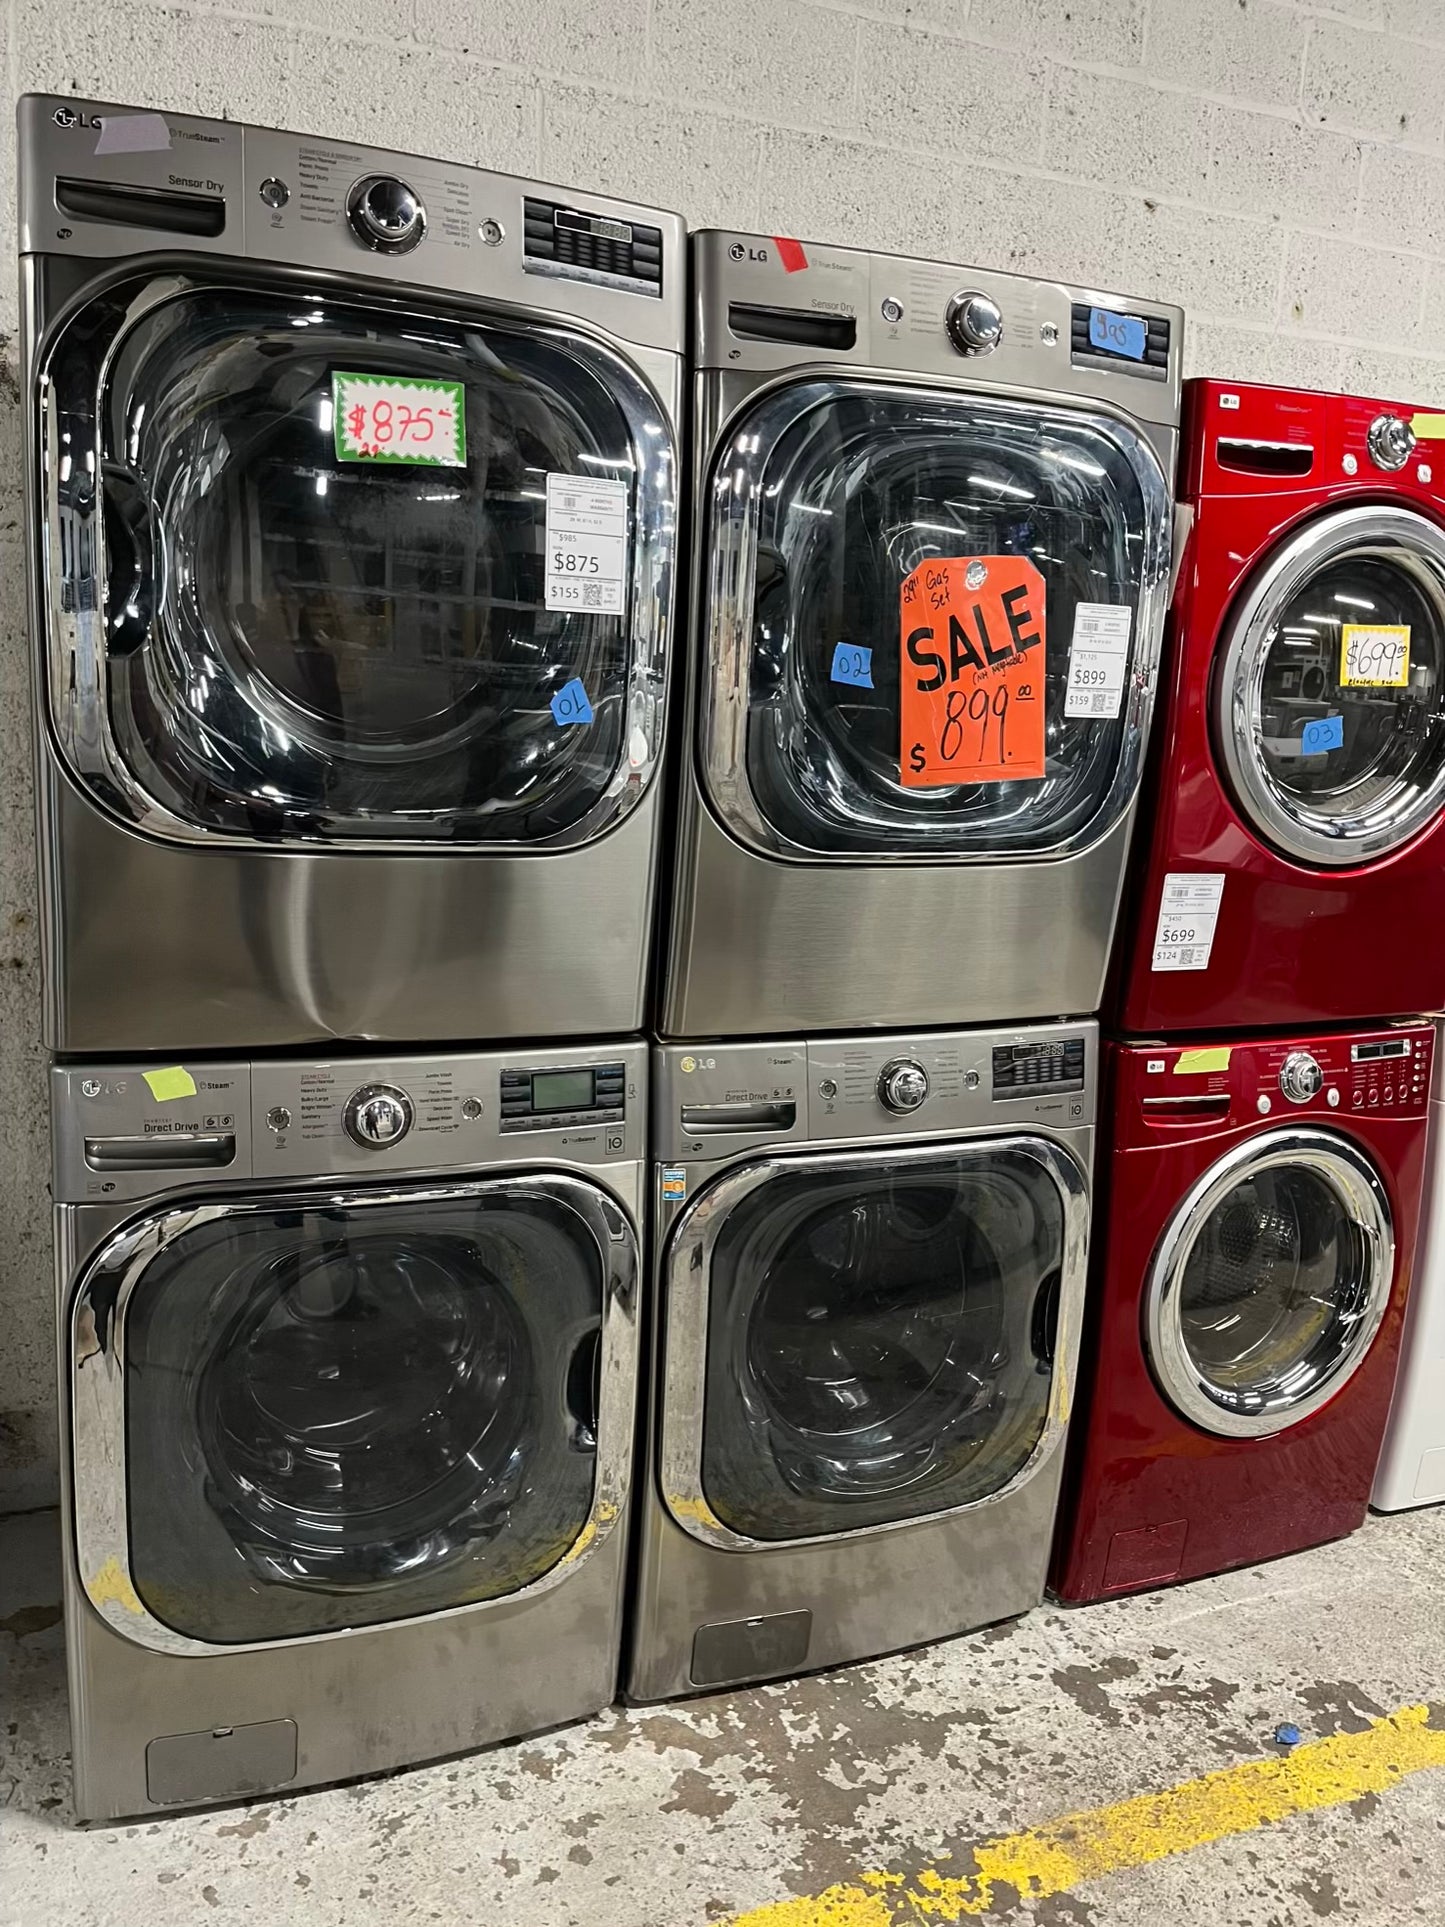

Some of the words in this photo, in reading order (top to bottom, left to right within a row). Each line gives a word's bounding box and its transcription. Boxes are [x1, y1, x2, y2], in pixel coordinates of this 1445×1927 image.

[168, 174, 203, 189] Sensor
[206, 179, 225, 194] Dry
[749, 248, 768, 263] LG
[811, 298, 840, 311] Sensor
[840, 302, 855, 314] Dry
[559, 533, 577, 542] $985
[554, 551, 599, 573] $875
[926, 568, 950, 590] Gas
[551, 586, 579, 599] $155
[931, 589, 951, 610] Set
[907, 584, 1042, 692] SALE
[838, 652, 871, 678] 02
[1074, 669, 1106, 686] $899
[1069, 695, 1089, 705] $159
[1308, 723, 1334, 744] 03
[1162, 928, 1195, 944] $699
[1157, 951, 1177, 960] $124
[697, 1058, 716, 1070] LG
[104, 1080, 127, 1095] LG
[725, 1093, 748, 1102] Direct
[749, 1092, 768, 1101] Drive
[144, 1122, 172, 1133] Direct
[174, 1122, 199, 1132] Drive
